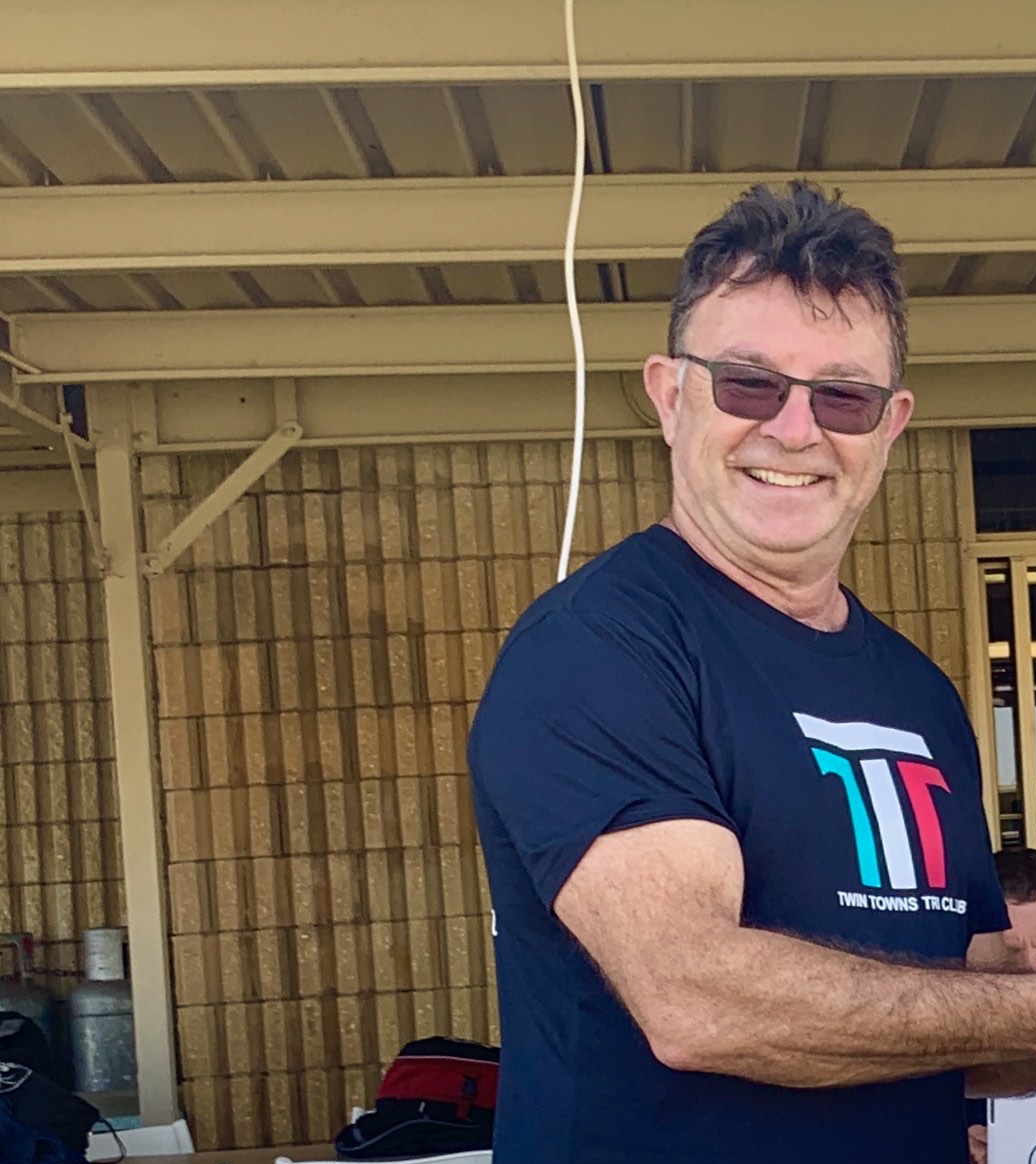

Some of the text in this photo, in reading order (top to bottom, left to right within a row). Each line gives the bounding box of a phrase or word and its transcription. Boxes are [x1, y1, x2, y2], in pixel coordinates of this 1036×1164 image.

[837, 891, 868, 908] TWIN
[868, 895, 919, 912] TOWNS
[921, 896, 941, 910] TRI
